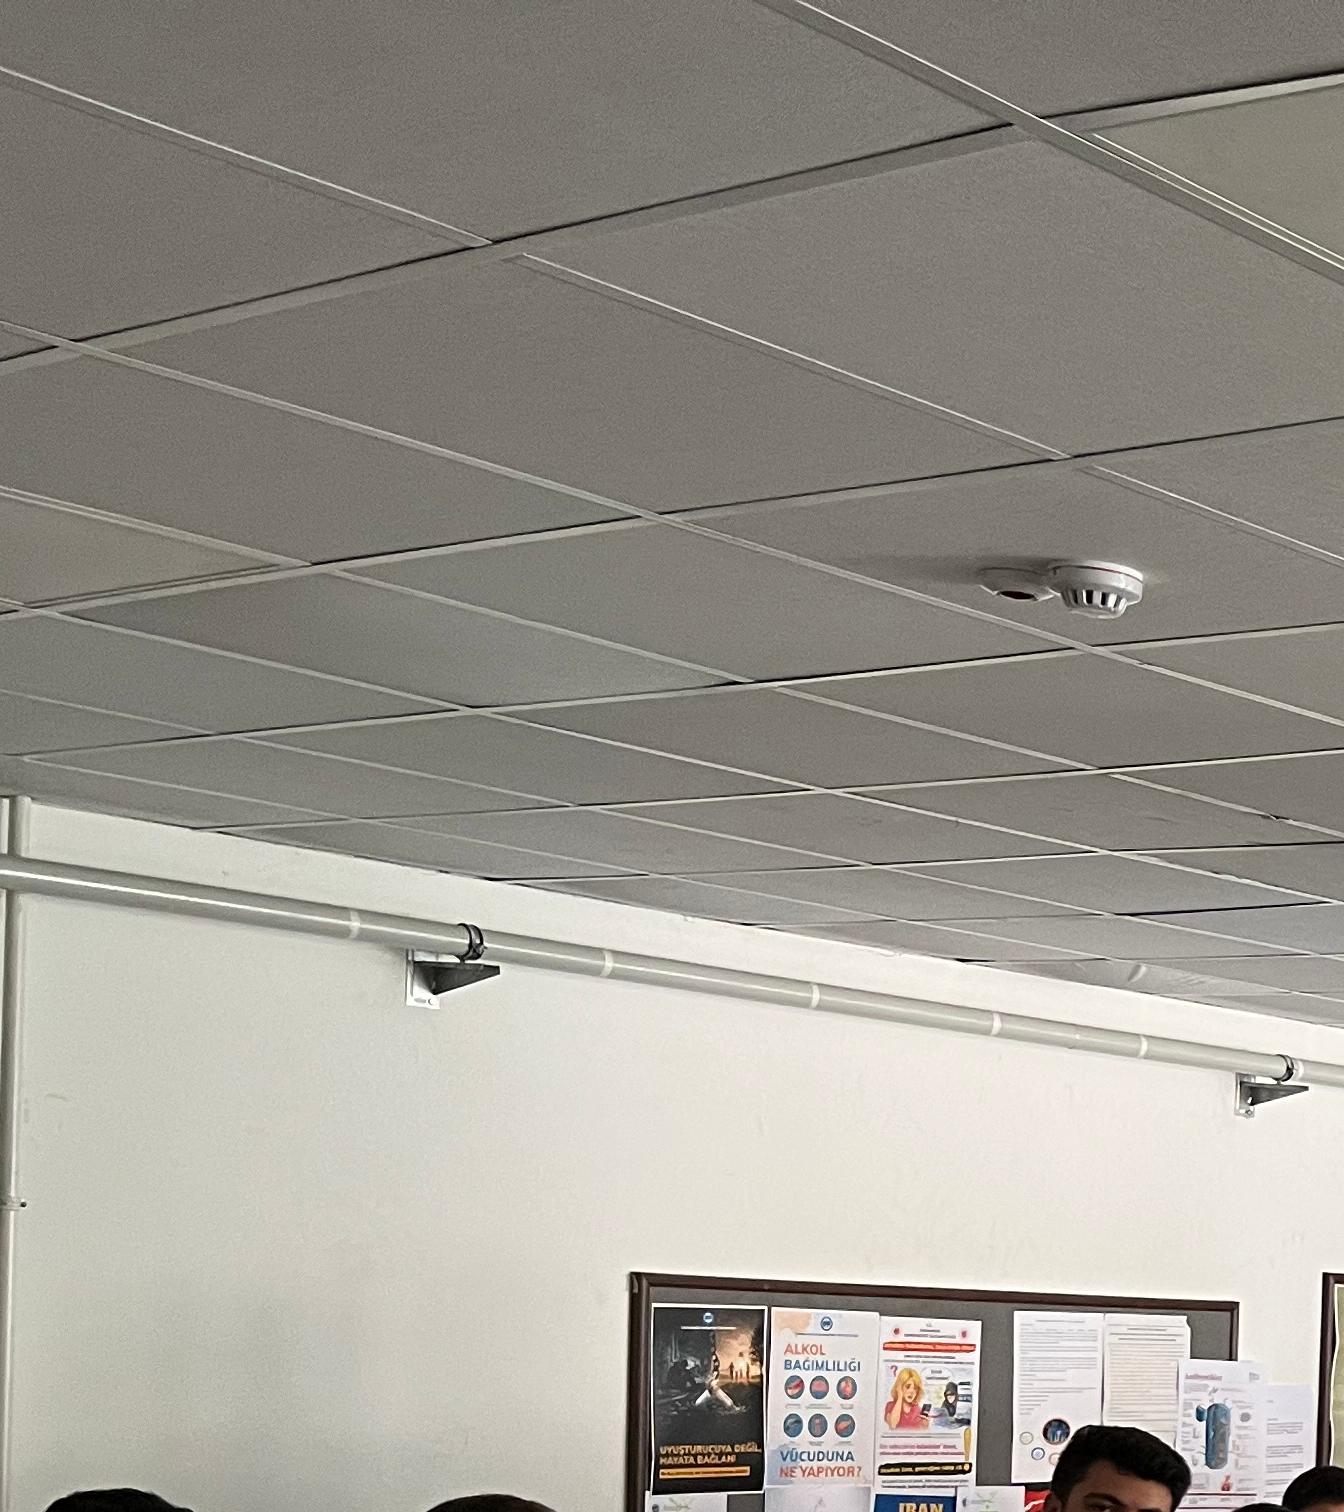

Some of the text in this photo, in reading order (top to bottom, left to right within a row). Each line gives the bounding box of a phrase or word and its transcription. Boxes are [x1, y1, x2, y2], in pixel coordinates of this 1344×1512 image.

[784, 1344, 826, 1356] ALKOL
[784, 1358, 861, 1372] BAĞIMLILIĞI
[780, 1449, 854, 1462] VÜCUDUNA
[779, 1466, 862, 1478] NE YAPIYOR?
